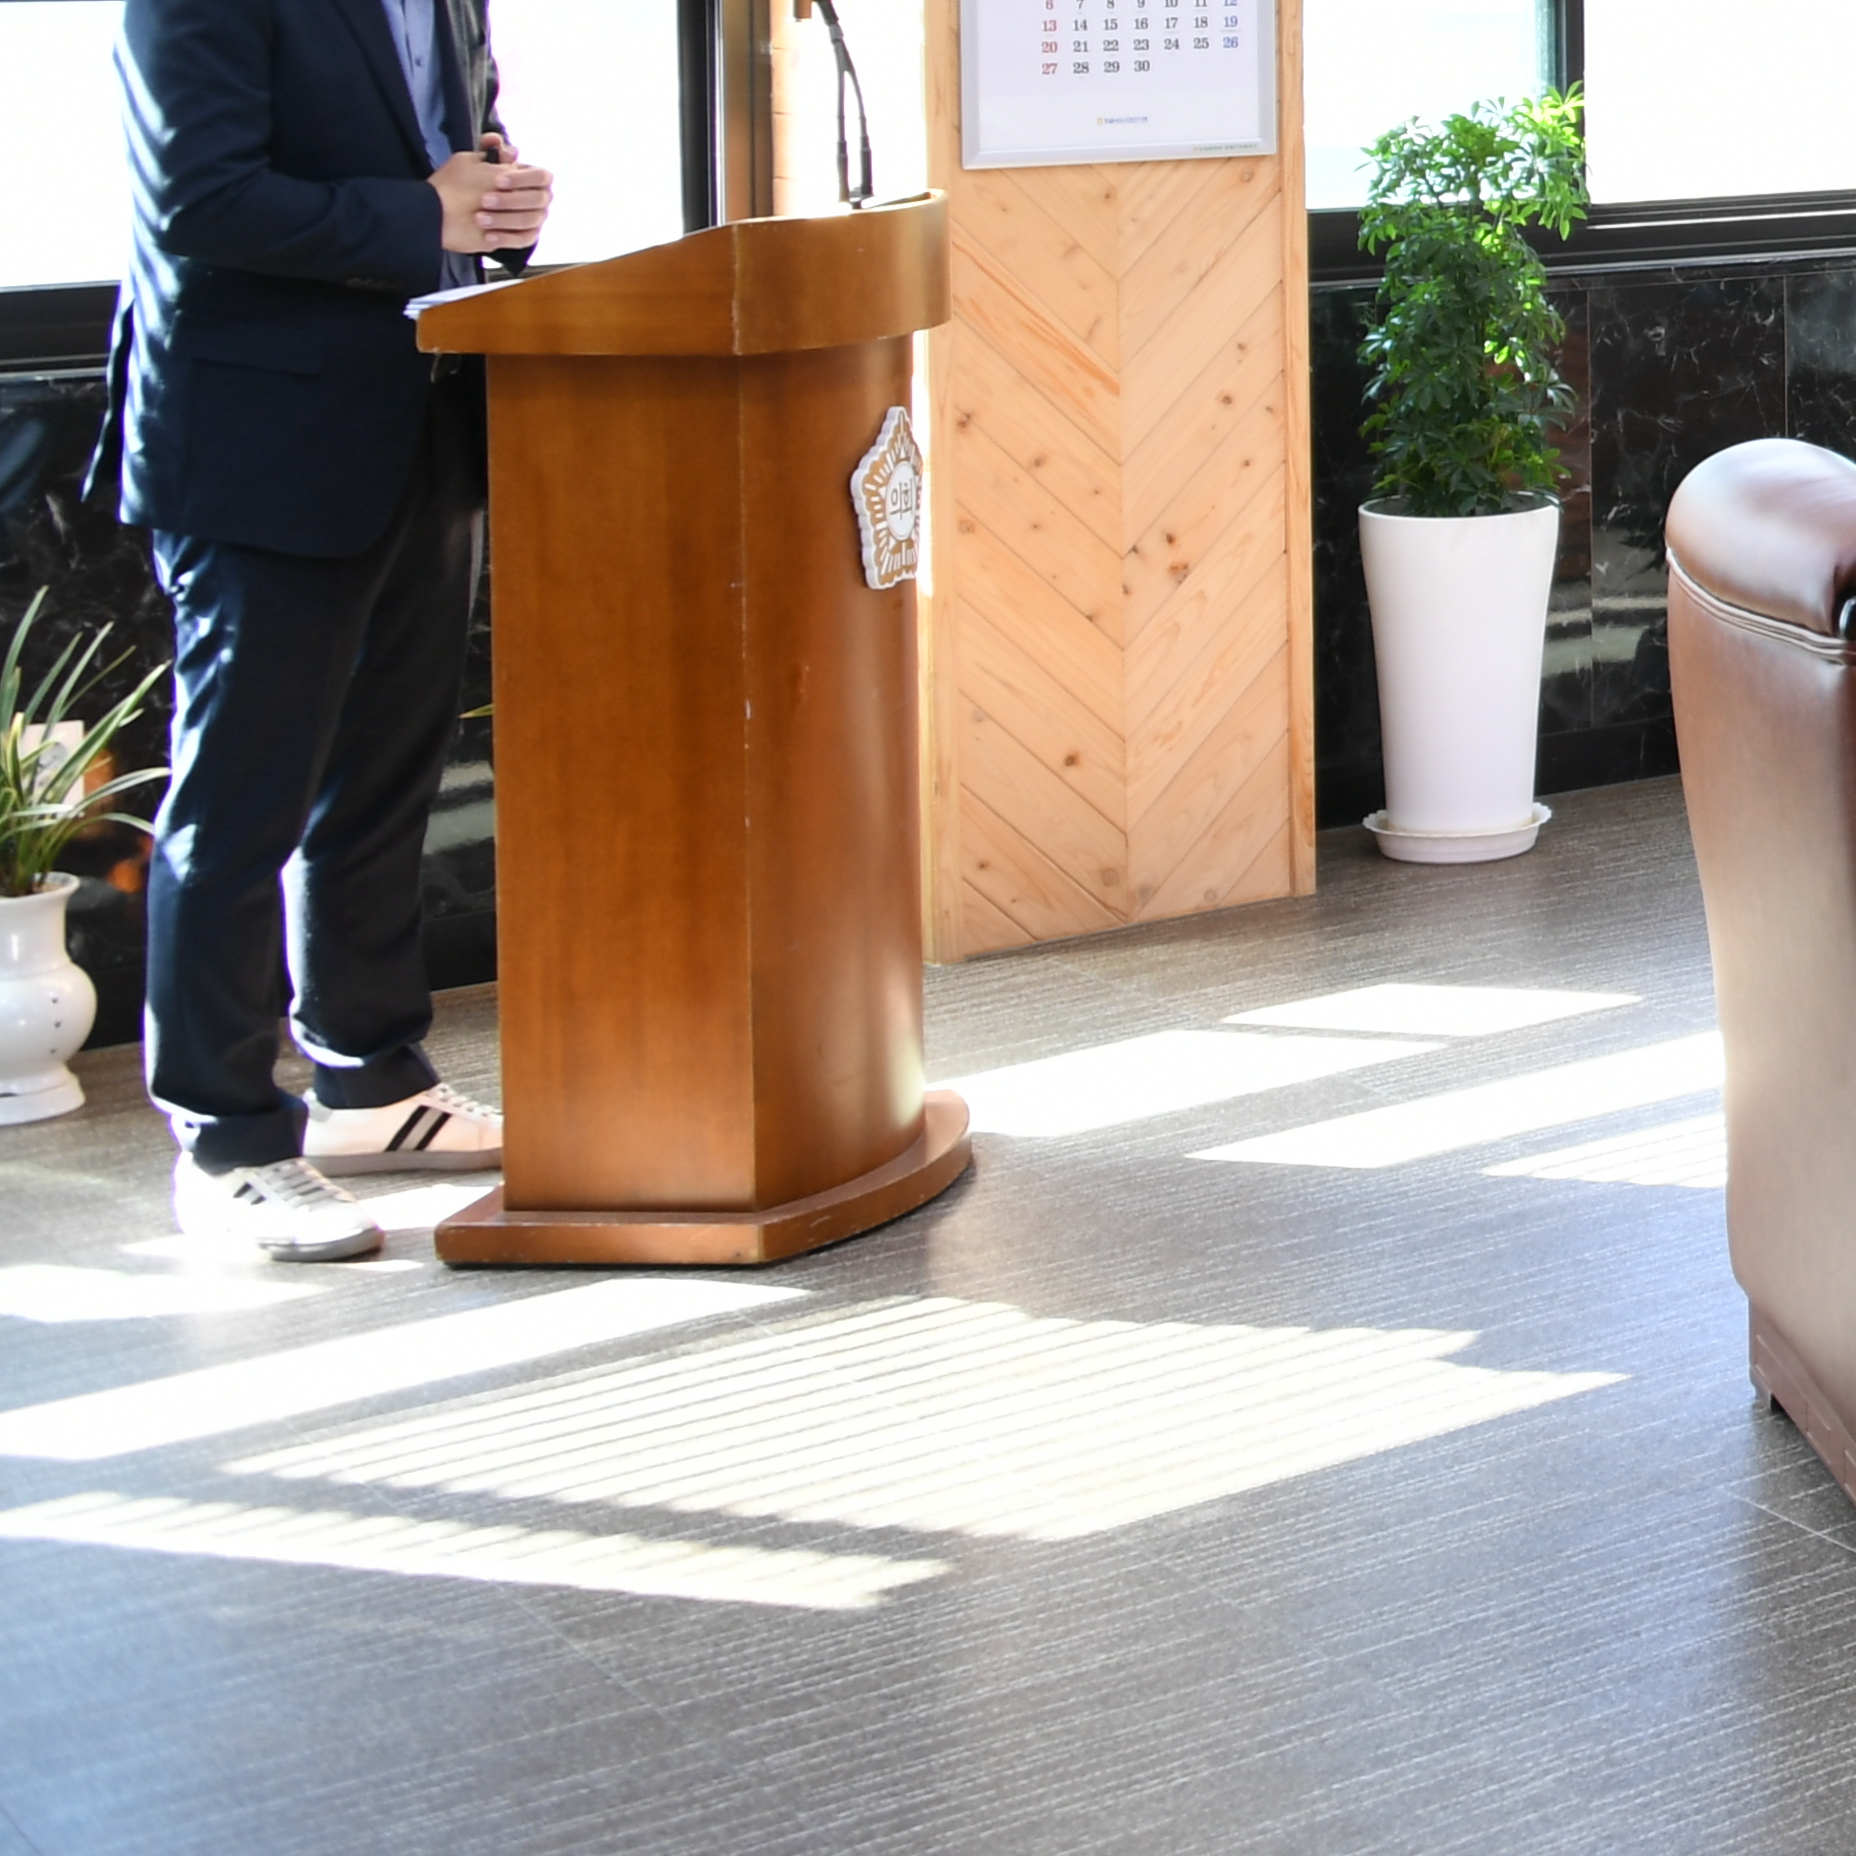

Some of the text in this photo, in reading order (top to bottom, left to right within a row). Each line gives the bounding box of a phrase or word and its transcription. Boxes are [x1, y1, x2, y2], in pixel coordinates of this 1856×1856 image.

[1043, 15, 1239, 33] 13 14 15 16 17 18 19
[1041, 36, 1239, 54] 20 21 22 23 24 25 26
[1041, 59, 1151, 76] 27 28 29 30
[890, 477, 914, 521] 의회
